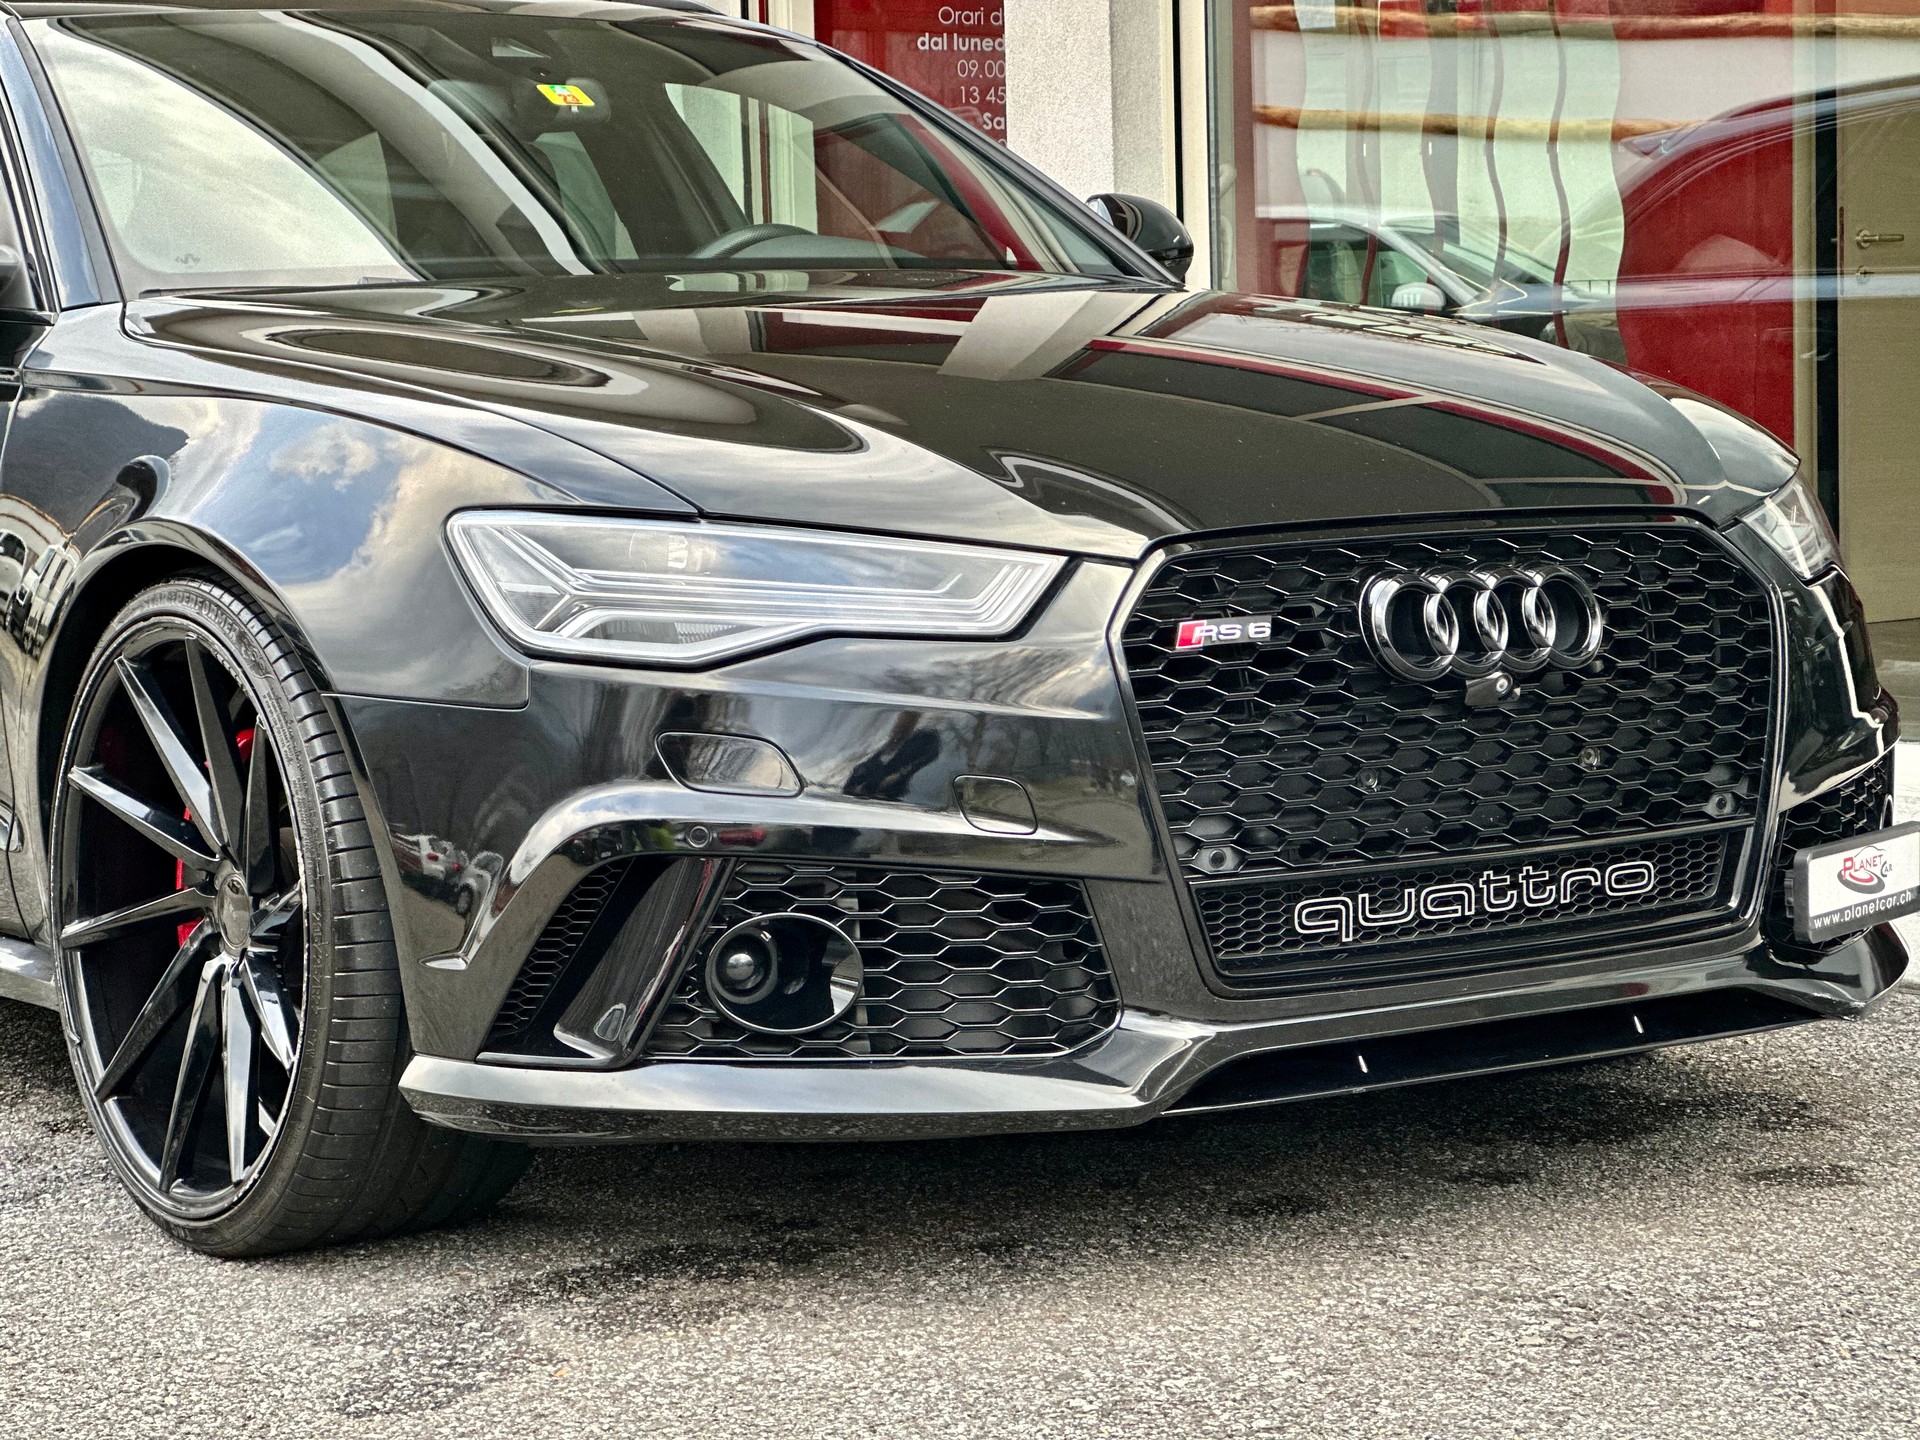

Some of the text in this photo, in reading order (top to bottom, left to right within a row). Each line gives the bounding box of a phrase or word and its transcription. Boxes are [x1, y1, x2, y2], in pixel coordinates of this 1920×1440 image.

[938, 6, 984, 25] Orari
[917, 32, 949, 51] dal
[957, 59, 1005, 78] 09.00
[982, 112, 1005, 130] Sa
[1191, 622, 1272, 642] RS 6
[1843, 854, 1884, 880] PLANET
[1294, 860, 1655, 942] quattro
[1813, 889, 1912, 929] www.planetcar.ch
